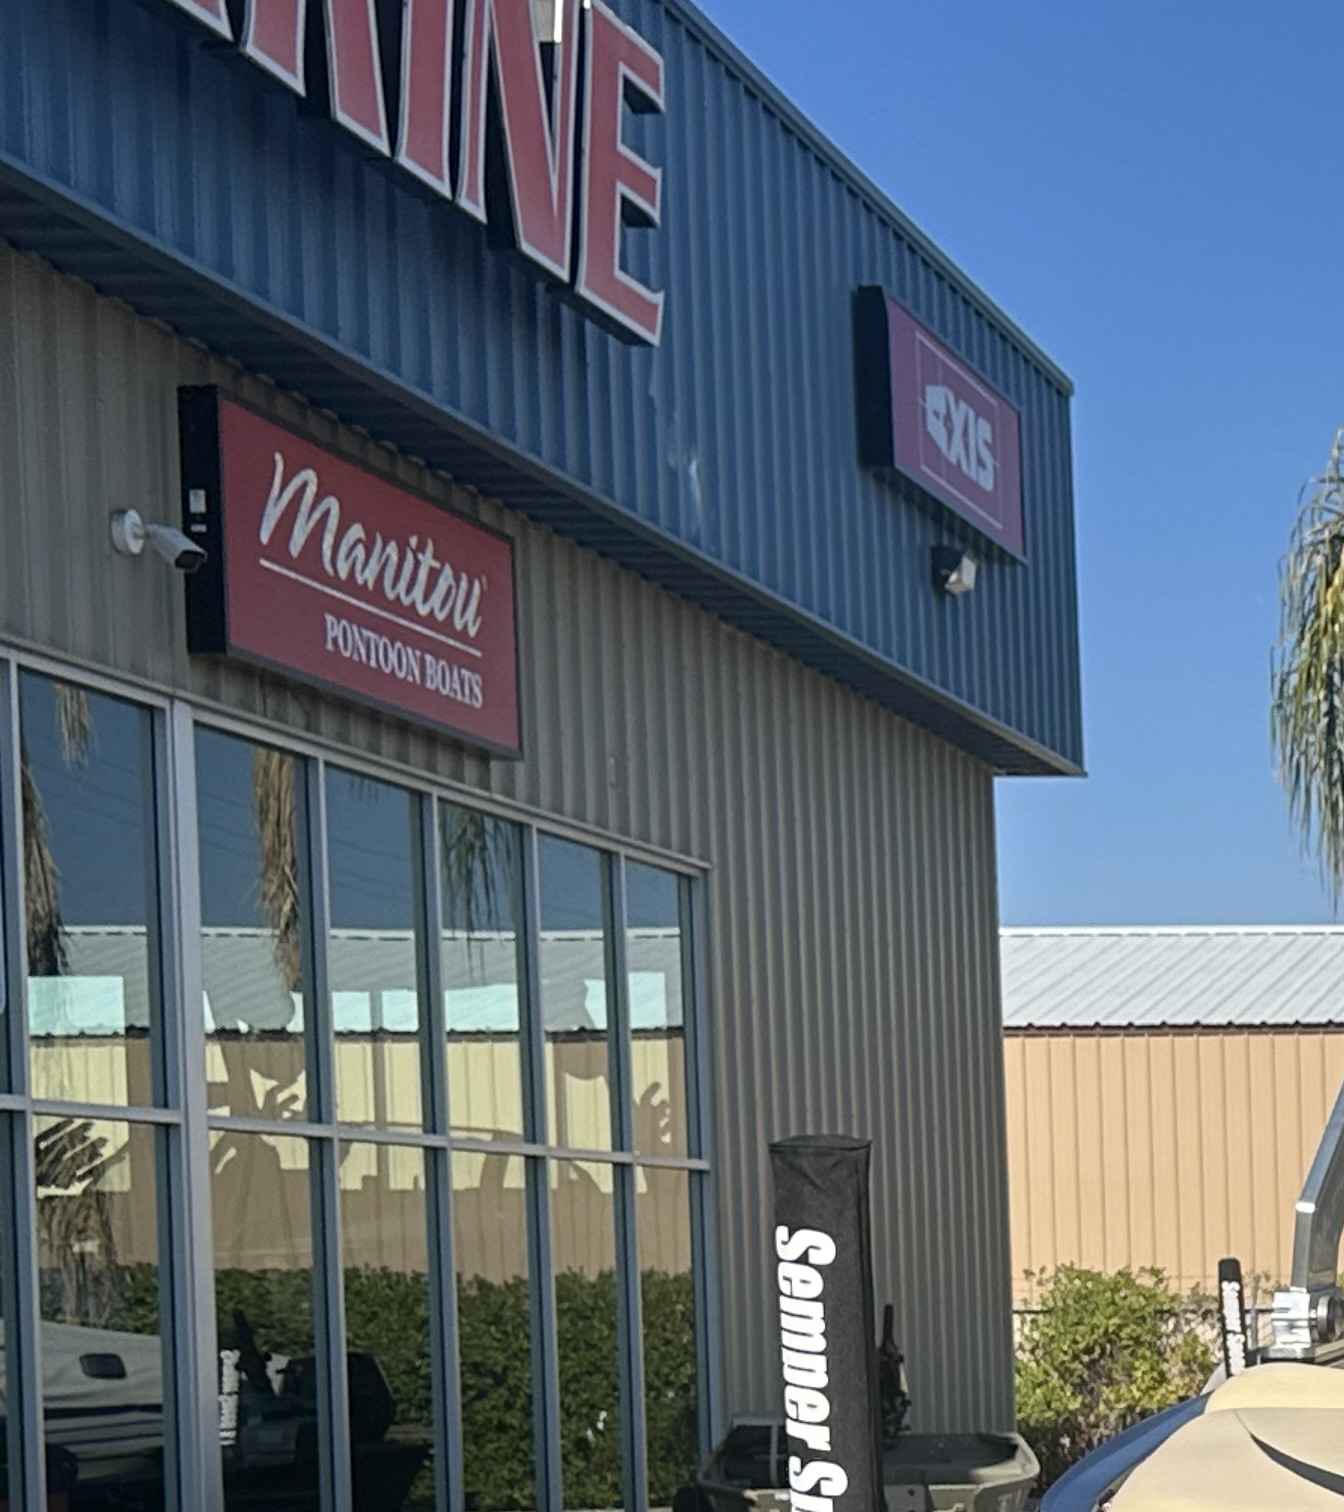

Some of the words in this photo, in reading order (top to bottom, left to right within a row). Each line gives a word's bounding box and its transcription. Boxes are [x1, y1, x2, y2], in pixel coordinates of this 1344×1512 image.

[259, 451, 482, 638] Manitou
[324, 612, 421, 686] PONTOON
[426, 654, 483, 709] BOATS
[774, 1224, 837, 1452] Semper
